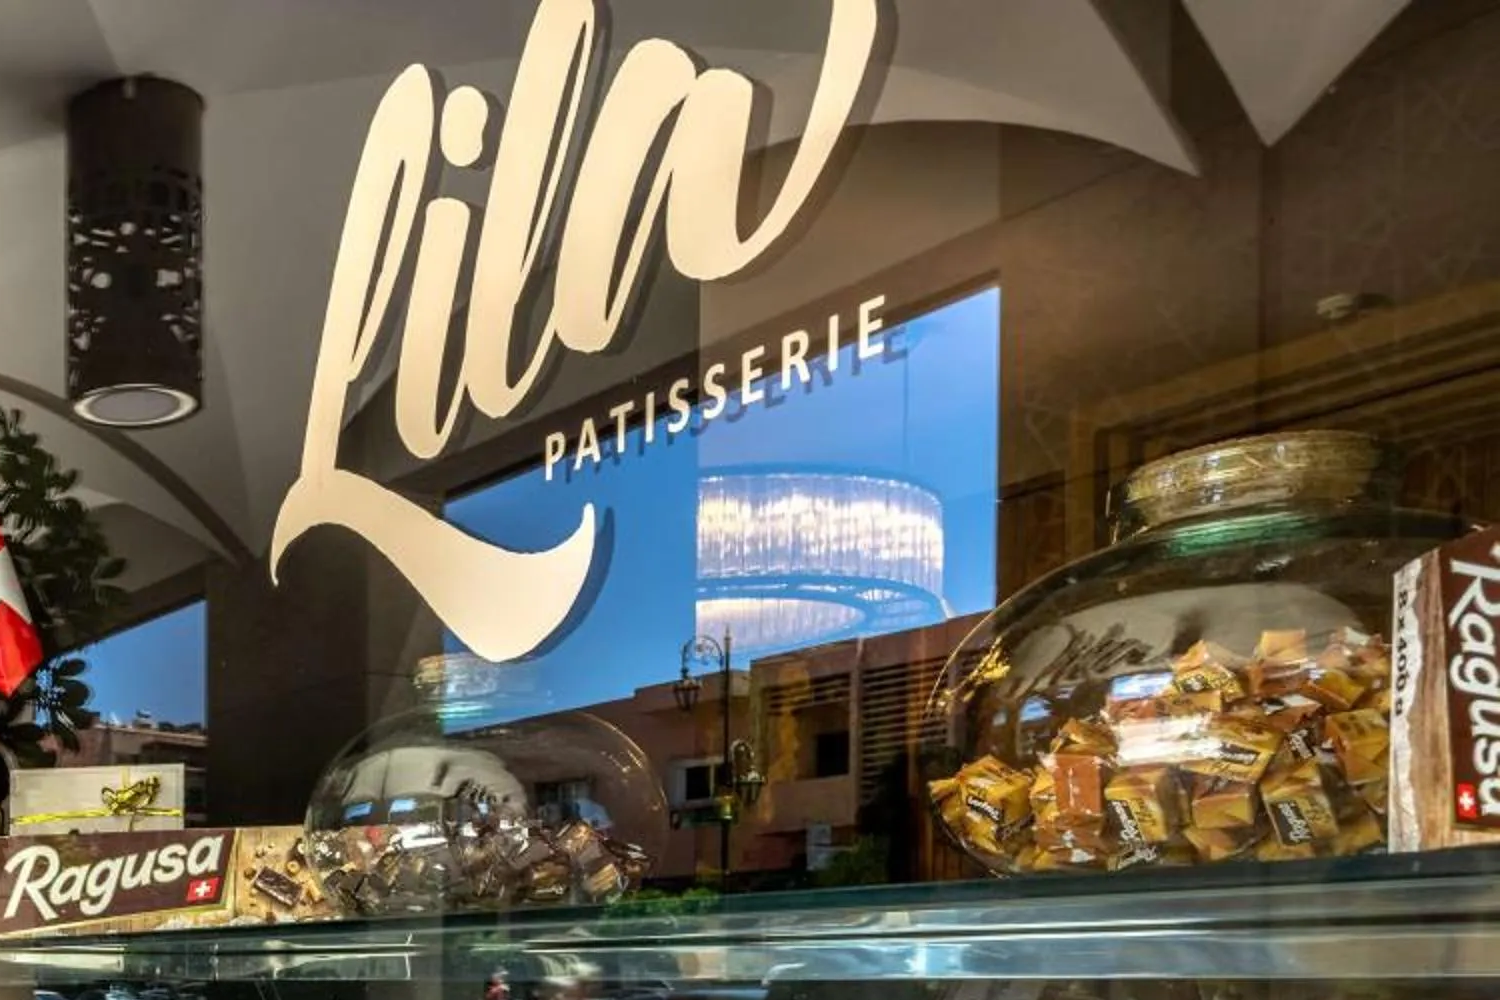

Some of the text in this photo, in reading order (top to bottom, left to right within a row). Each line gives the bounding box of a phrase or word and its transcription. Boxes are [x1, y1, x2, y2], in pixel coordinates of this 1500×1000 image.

[270, 0, 882, 662] Lila
[544, 294, 890, 482] PATISSERIE
[3, 833, 225, 920] Ragusa
